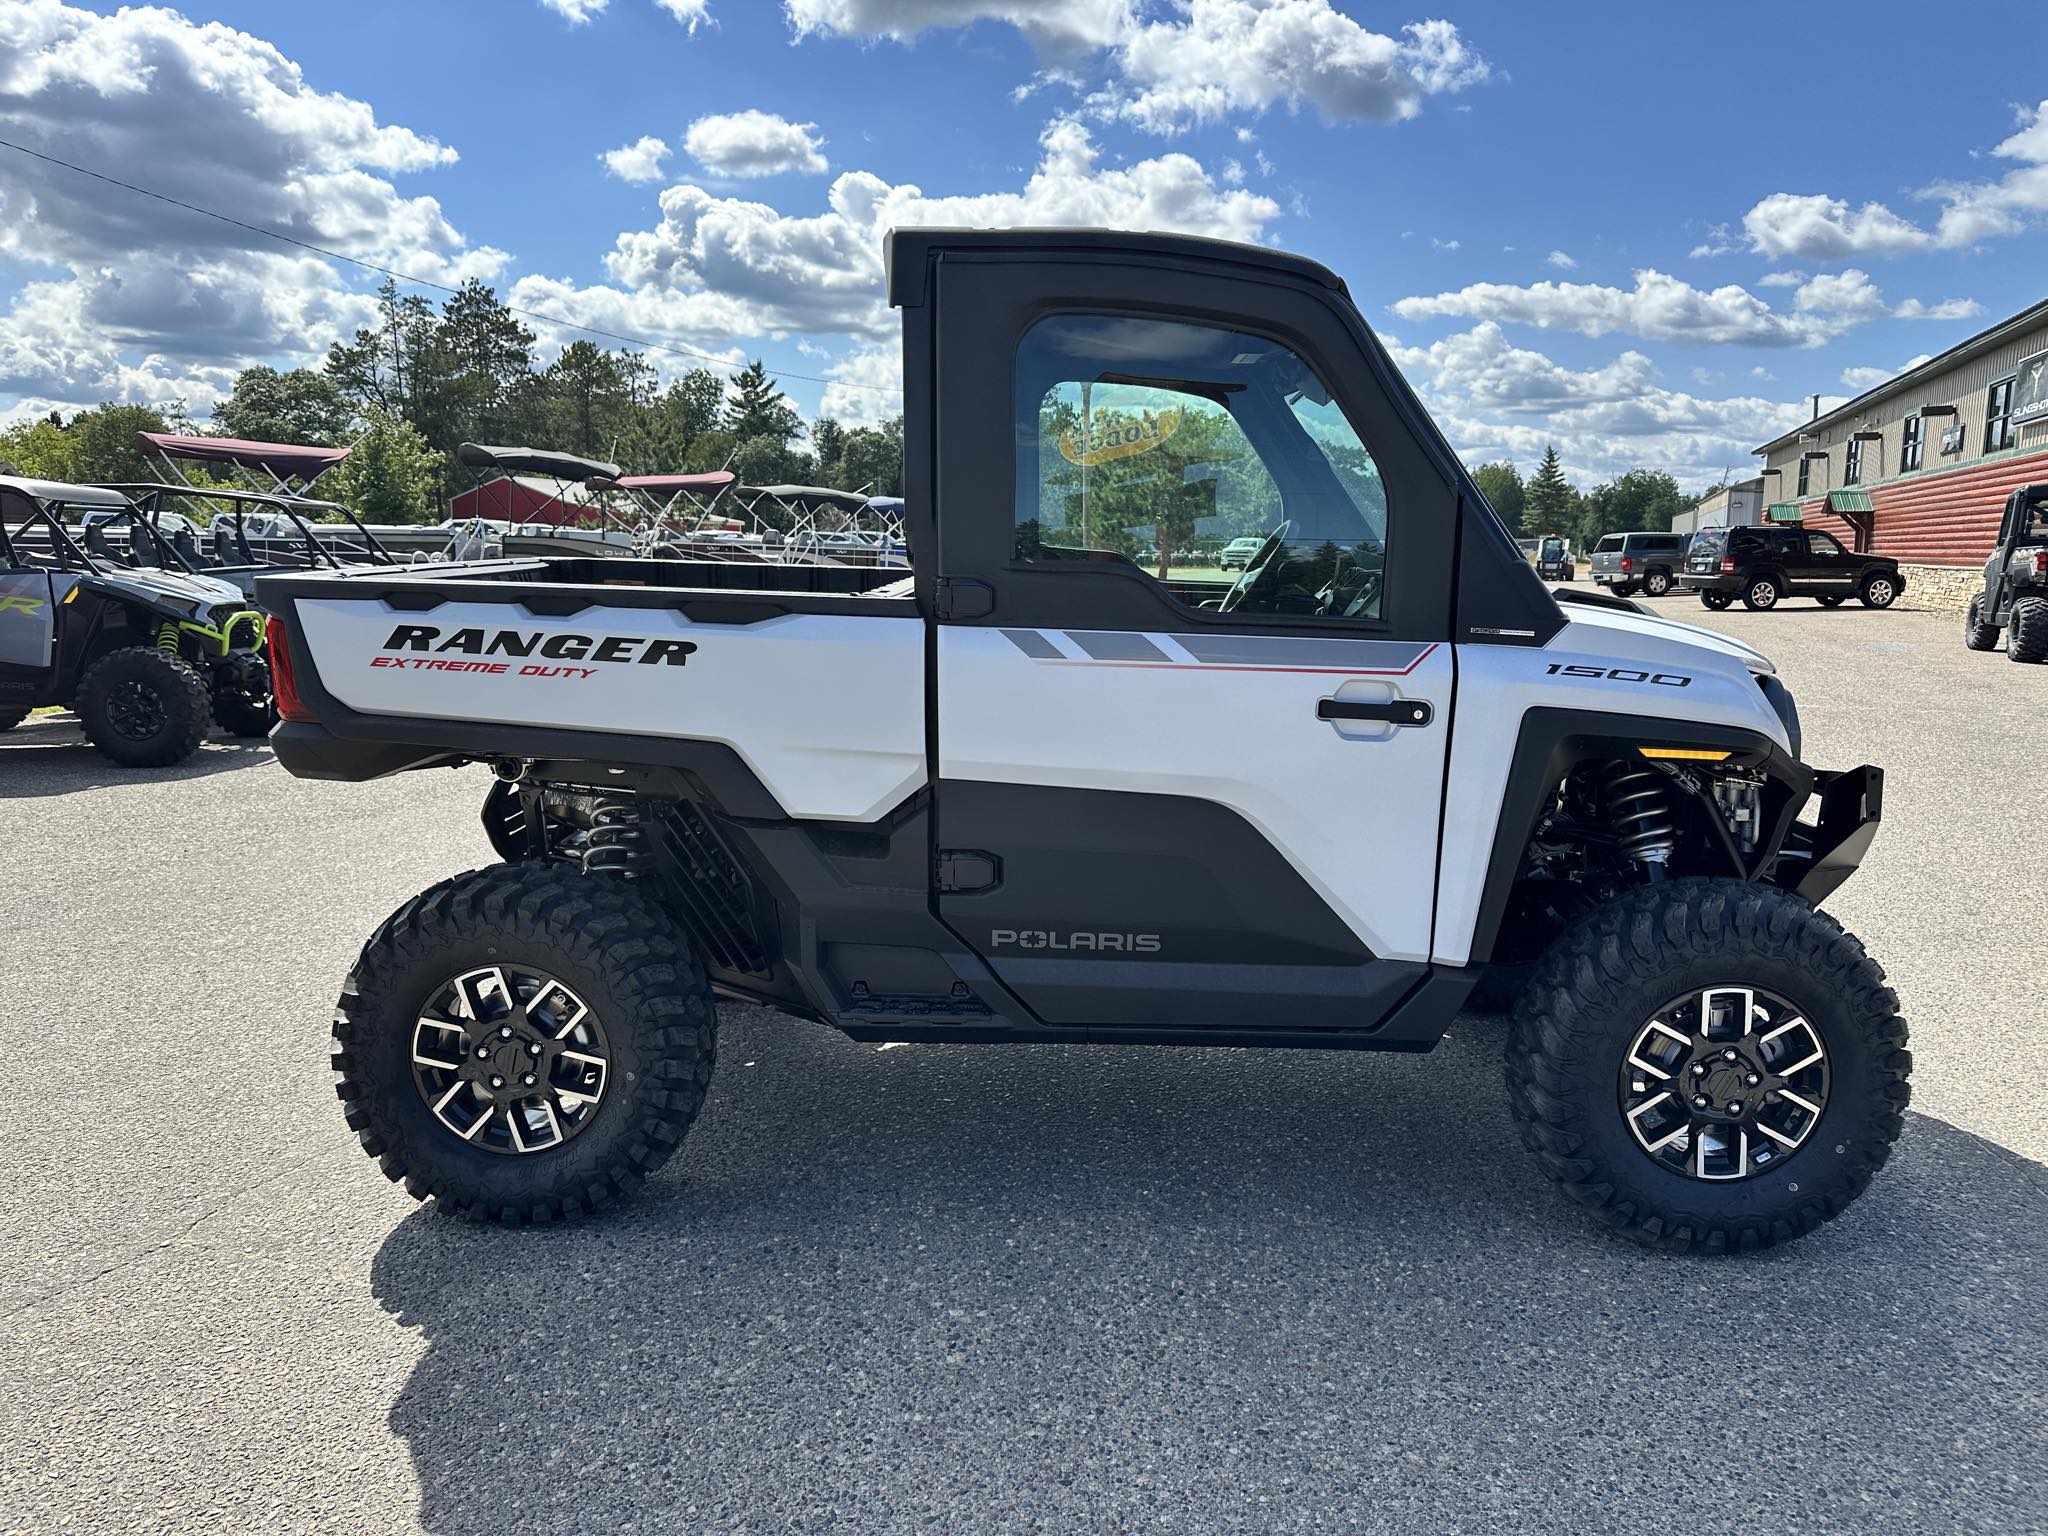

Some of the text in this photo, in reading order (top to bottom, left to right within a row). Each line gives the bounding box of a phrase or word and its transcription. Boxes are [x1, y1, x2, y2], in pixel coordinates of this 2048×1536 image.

[382, 624, 699, 667] RANGER
[369, 656, 599, 679] EXTREME DUTY
[1546, 663, 1692, 688] 1500
[991, 929, 1162, 952] POLARIS
